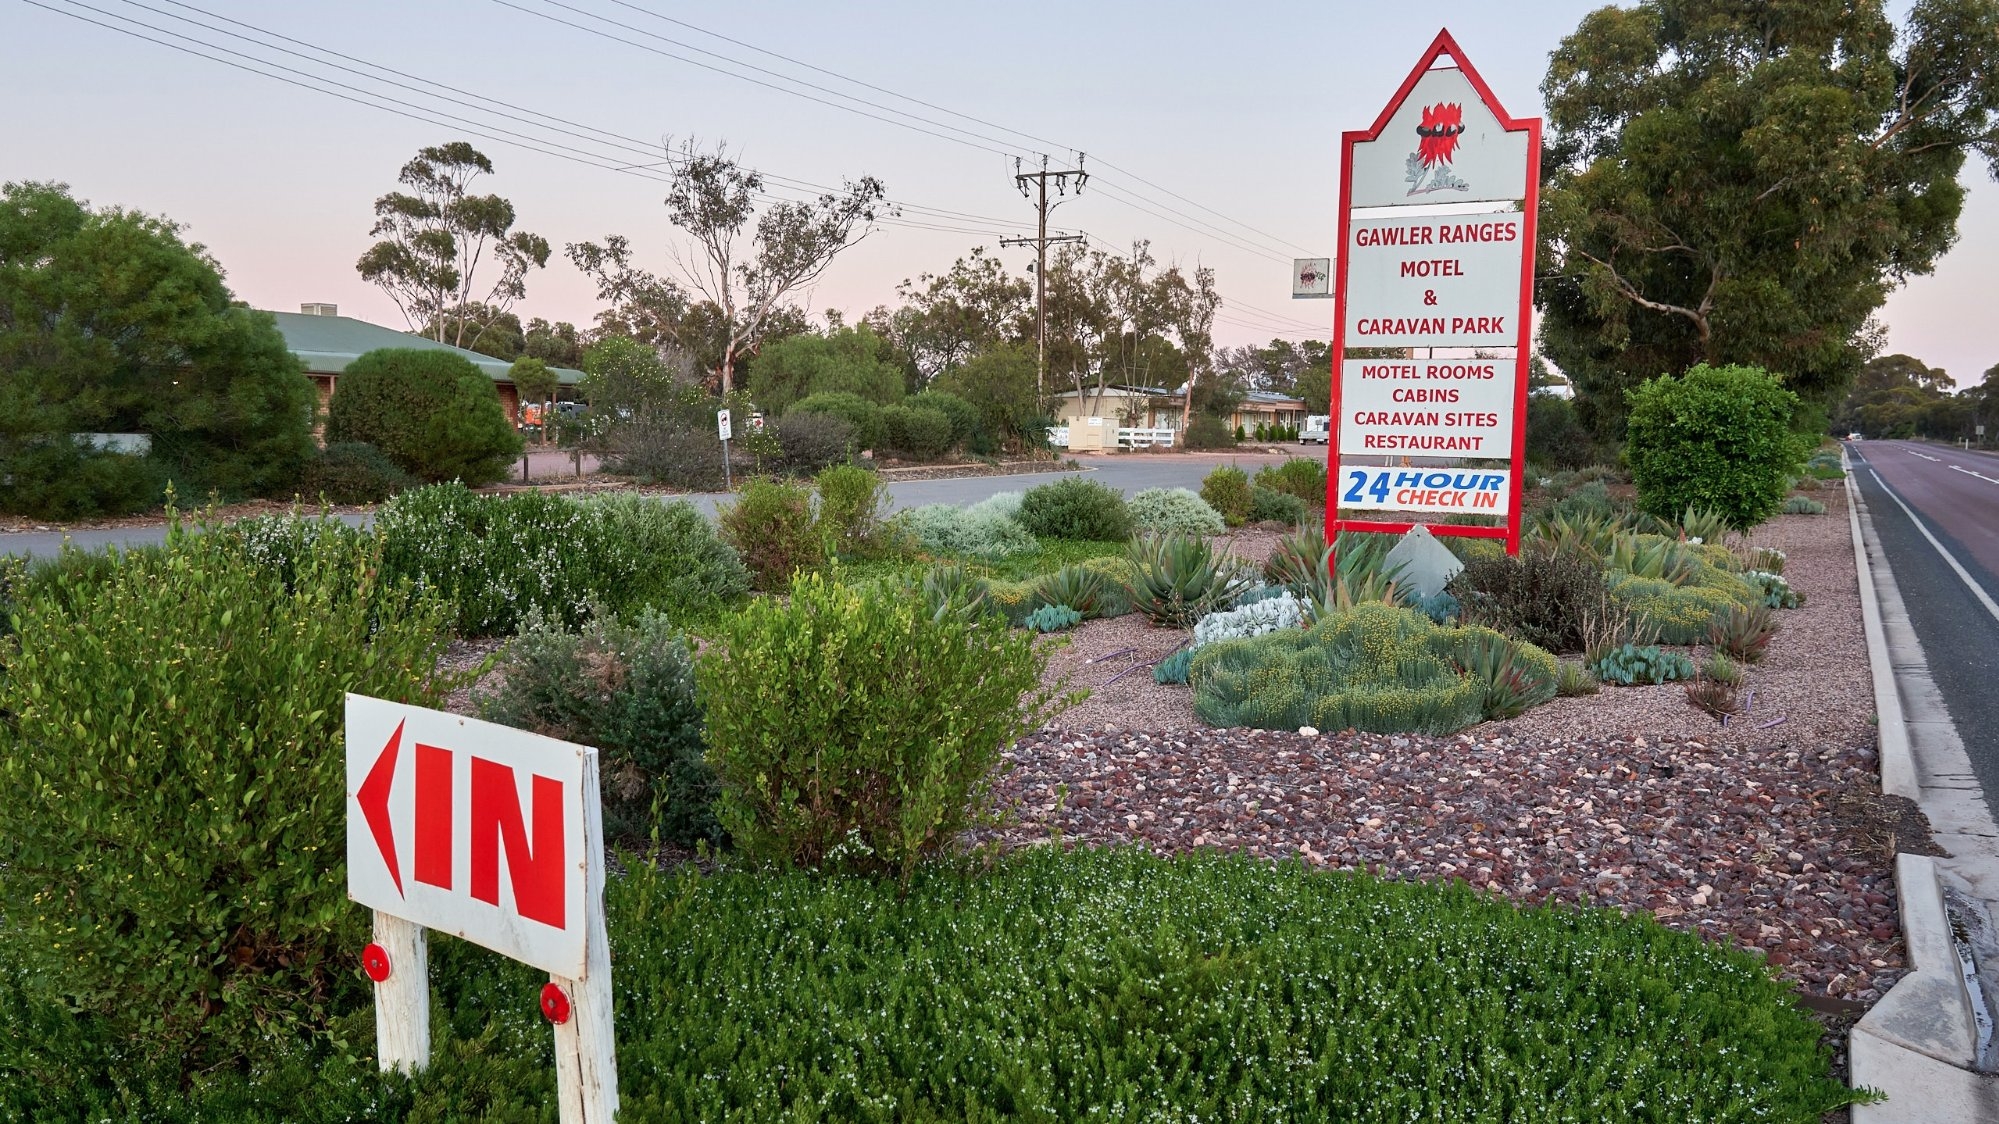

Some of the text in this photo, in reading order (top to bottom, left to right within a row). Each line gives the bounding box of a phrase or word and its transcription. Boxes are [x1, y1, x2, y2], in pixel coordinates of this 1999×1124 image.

[1356, 223, 1517, 246] GAWLER RANGES
[1400, 260, 1464, 277] MOTEL
[1423, 289, 1438, 305] &
[1357, 317, 1504, 335] CARAVAN PARK
[1362, 366, 1494, 379] MOTEL ROOMS
[1392, 389, 1459, 402] CABINS
[1354, 412, 1498, 427] CARAVAN SITES
[1364, 435, 1483, 450] RESTAURANT
[1343, 471, 1505, 503] 24 HOUR
[1396, 489, 1498, 508] CHECK IN
[414, 743, 565, 931] IN
